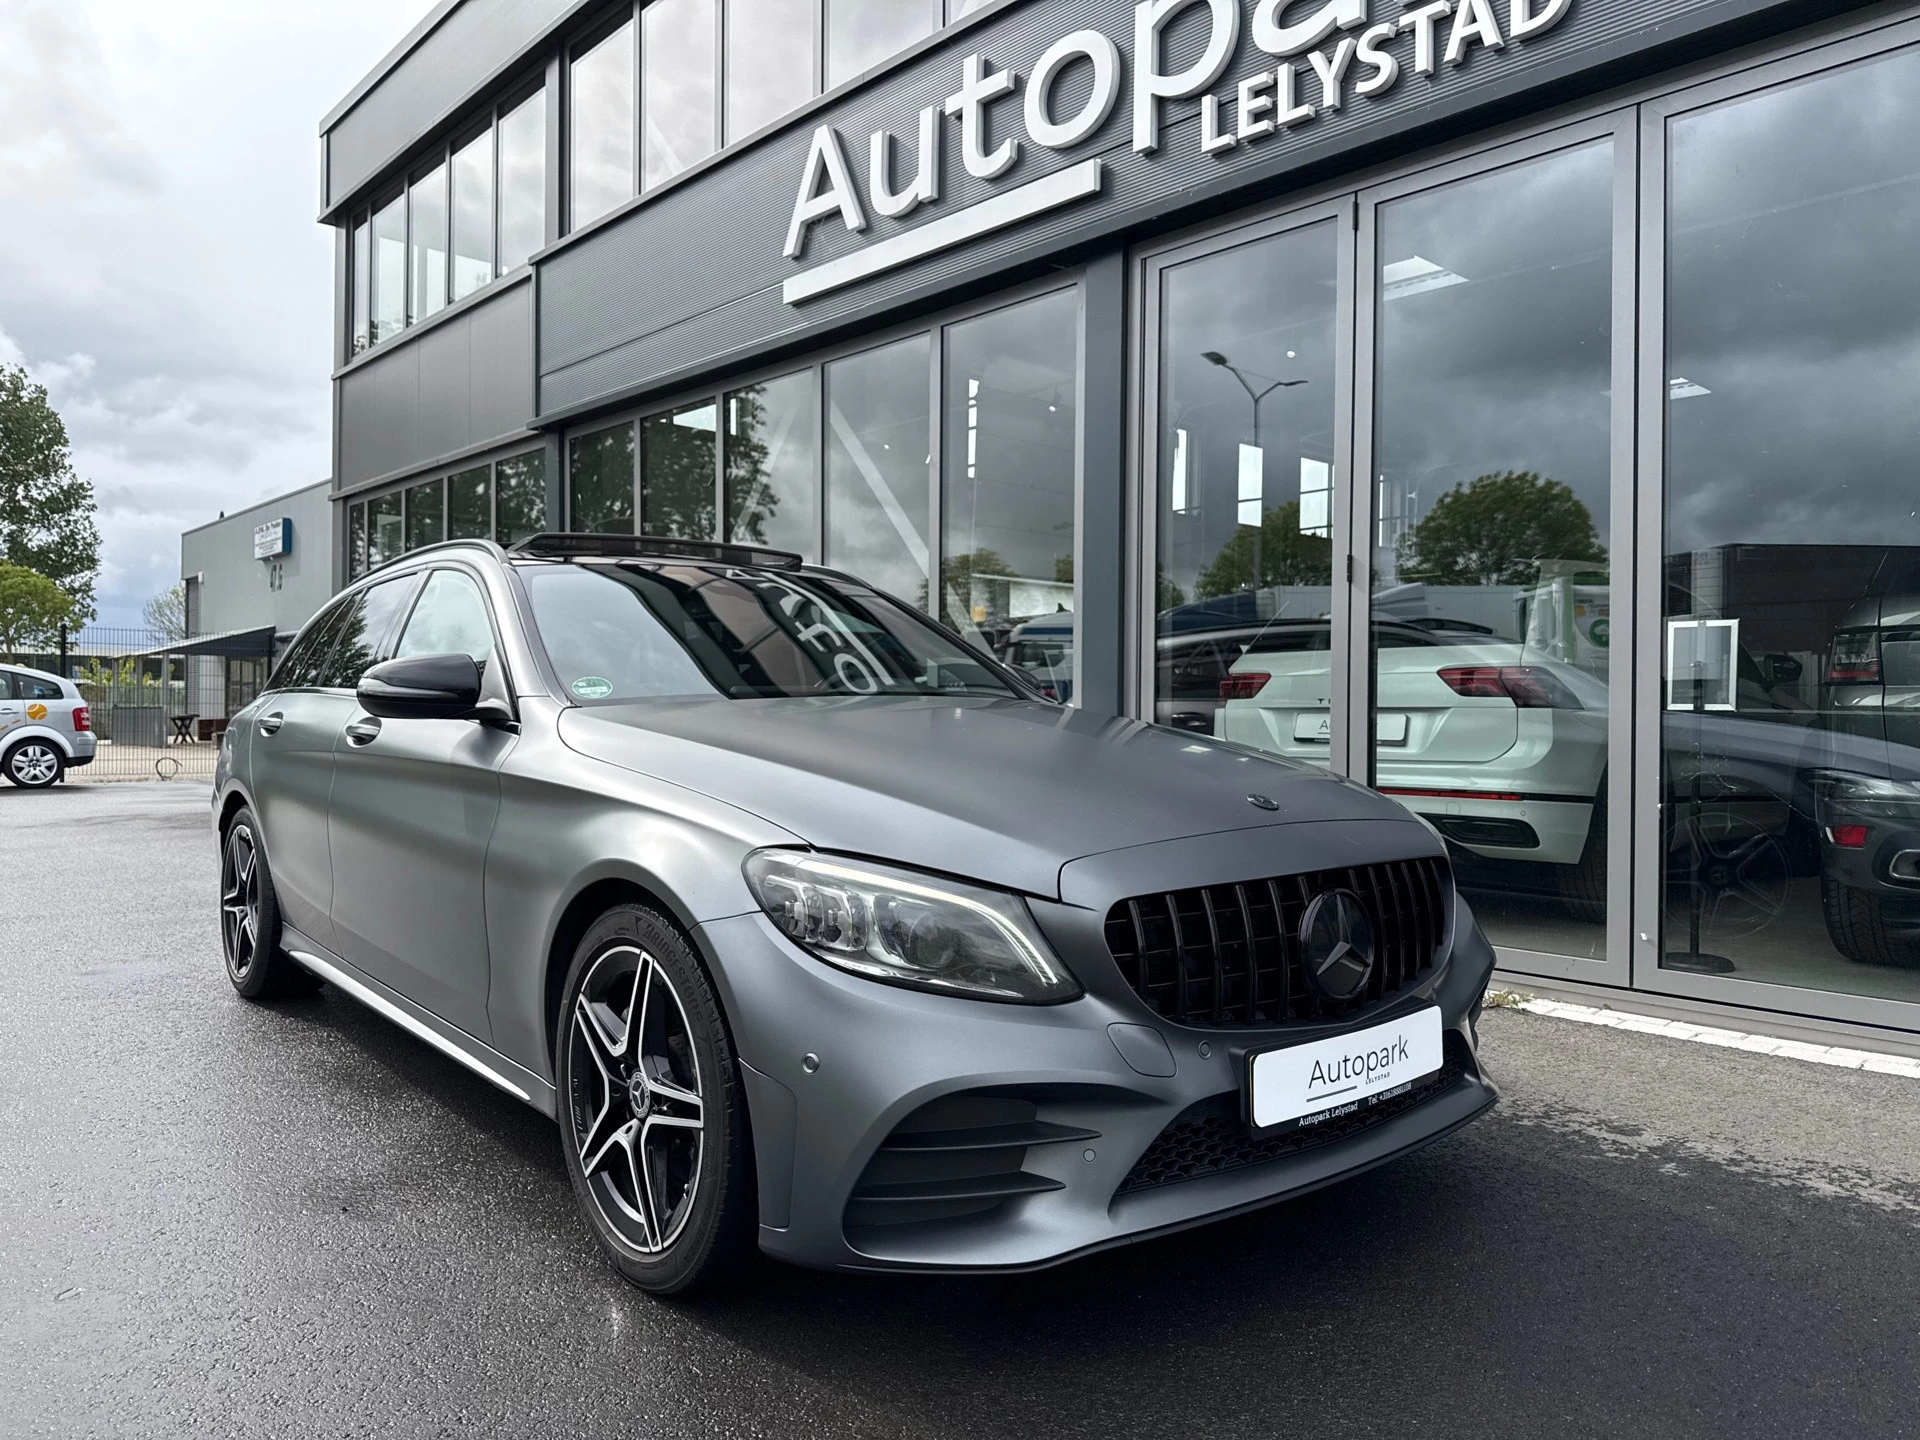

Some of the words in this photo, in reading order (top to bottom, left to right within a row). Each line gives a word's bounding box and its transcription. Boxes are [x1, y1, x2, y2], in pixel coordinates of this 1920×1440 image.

[1308, 1034, 1409, 1089] Autopark
[1365, 1071, 1391, 1085] LELYSTAD
[1298, 1109, 1331, 1127] Autopark
[1331, 1101, 1358, 1117] Lelystad
